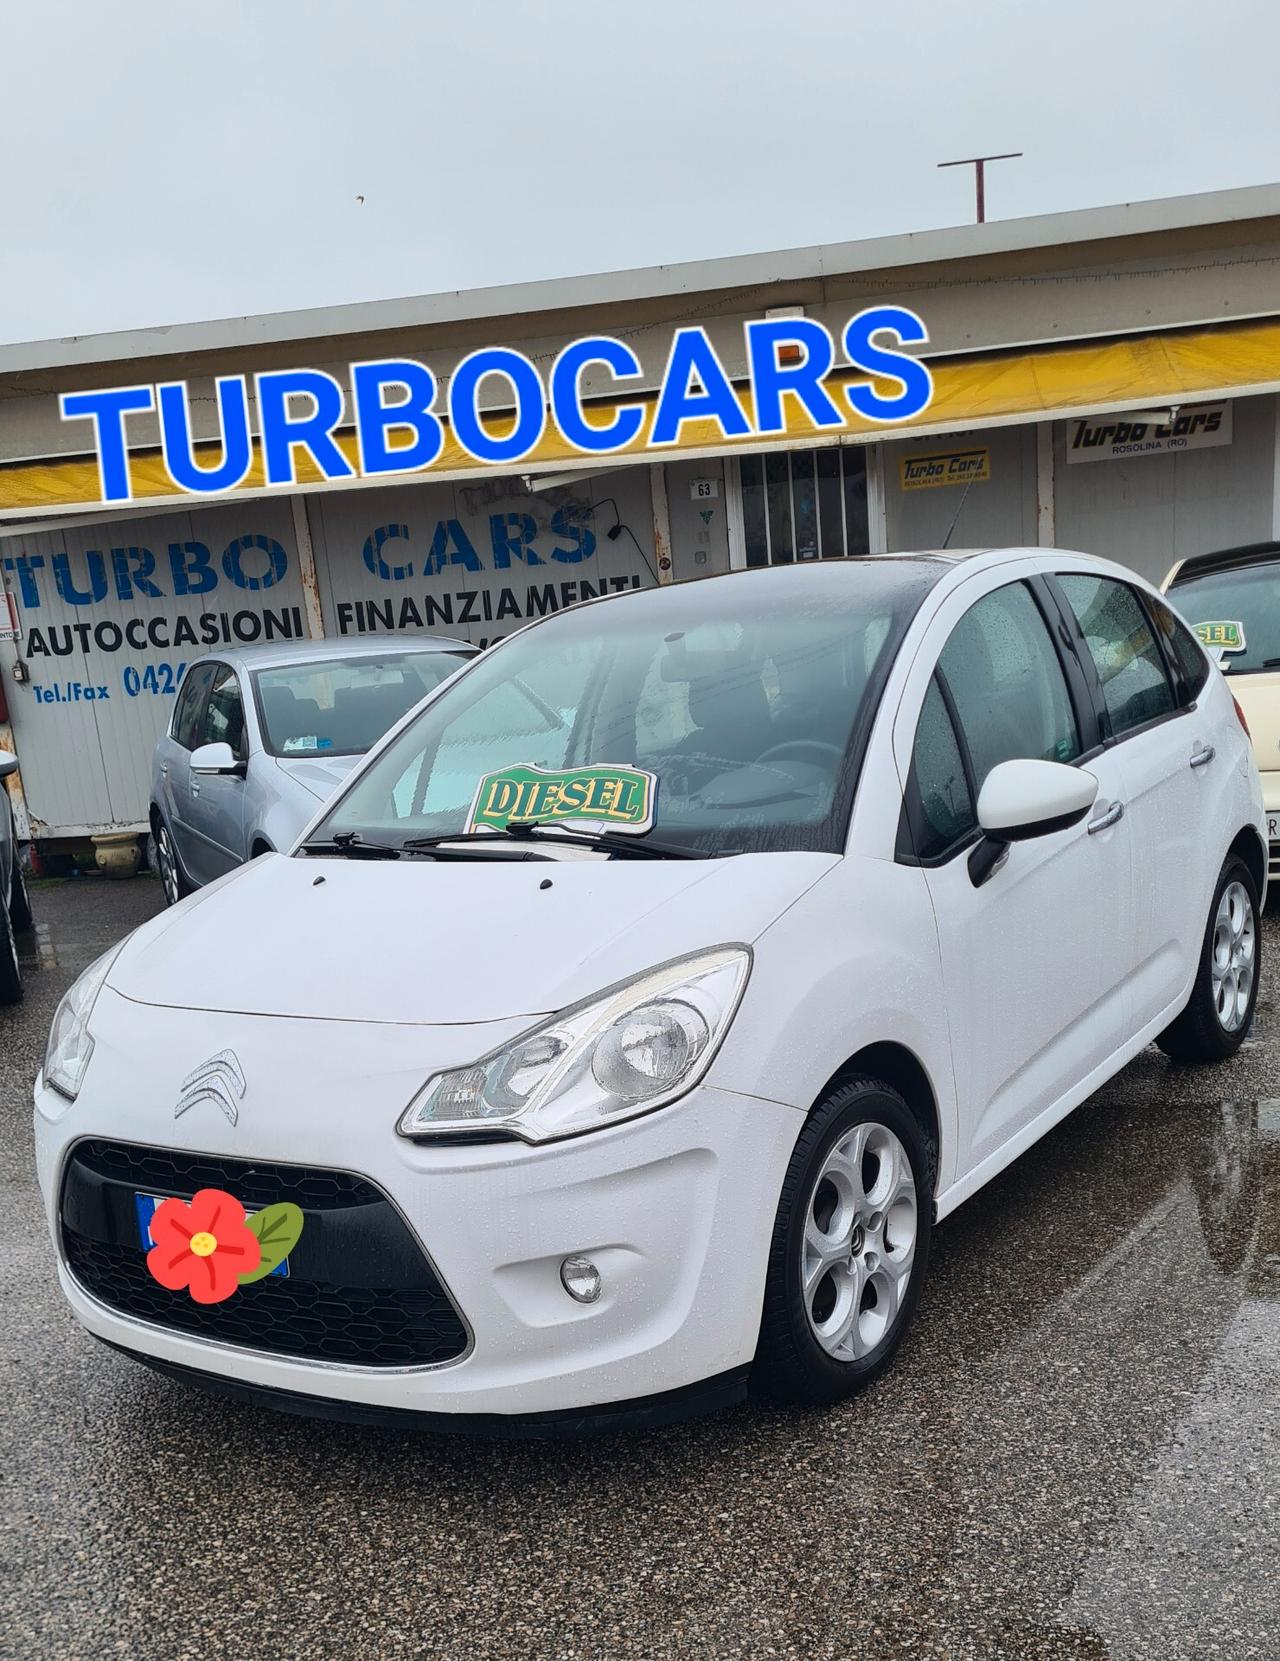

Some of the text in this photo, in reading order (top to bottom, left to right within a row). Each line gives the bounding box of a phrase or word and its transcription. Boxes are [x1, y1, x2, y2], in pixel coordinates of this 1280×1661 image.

[1072, 410, 1148, 449] Turbo
[1112, 437, 1188, 454] ROSOLINA (RO)
[904, 459, 944, 480] Turbo
[698, 483, 711, 496] 63
[4, 505, 597, 608] TURBO CARS
[26, 606, 304, 658] AUTOCCASIONI
[33, 682, 110, 703] Tel./Fax
[483, 777, 640, 821] DIESEL
